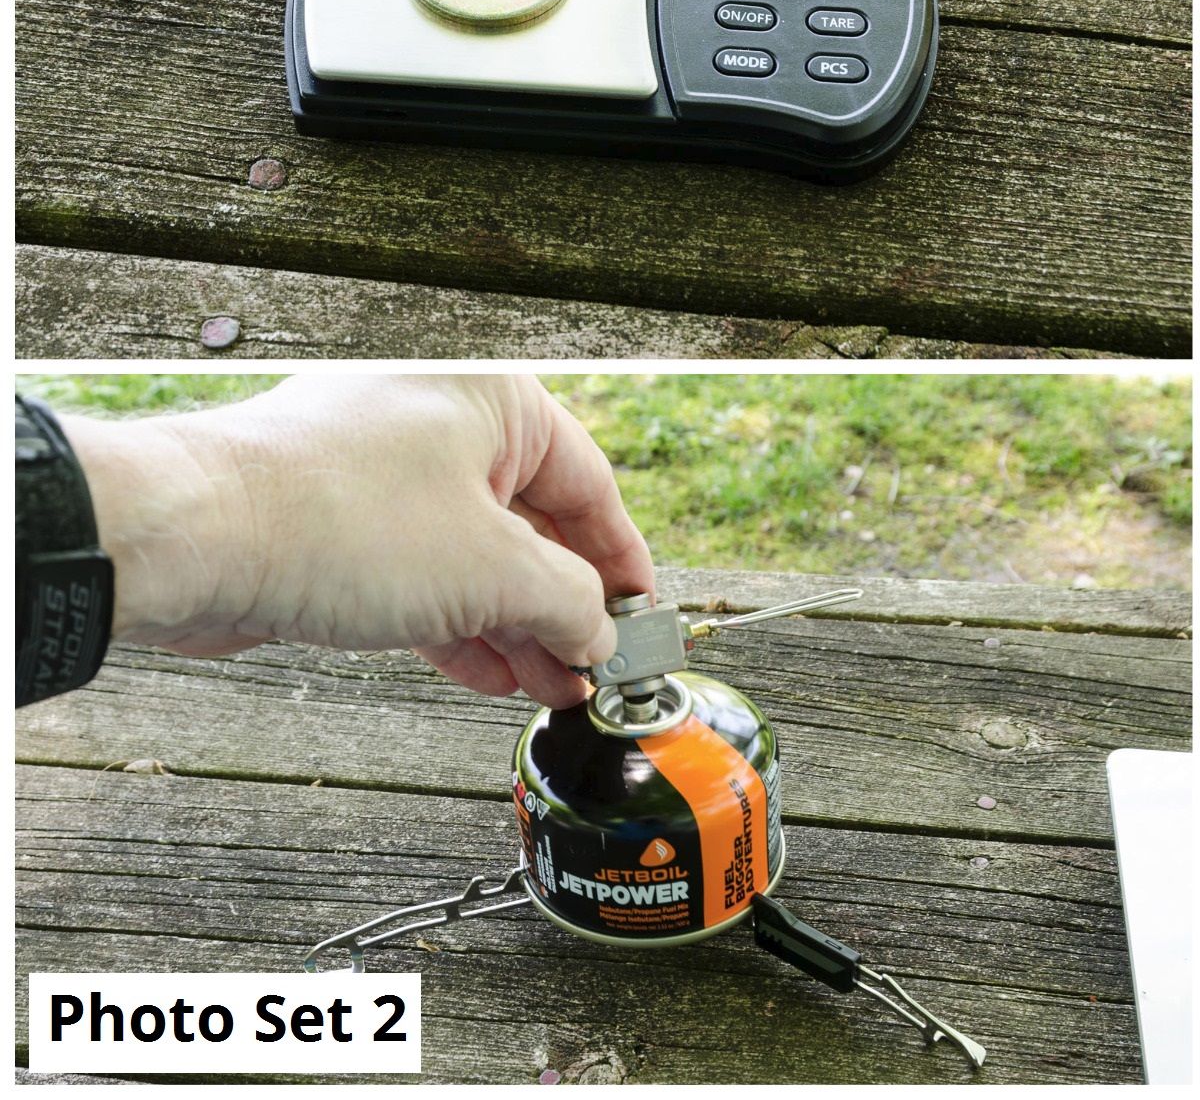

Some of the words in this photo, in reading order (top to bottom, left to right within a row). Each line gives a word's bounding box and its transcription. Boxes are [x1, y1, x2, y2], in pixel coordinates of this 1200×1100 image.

[719, 8, 773, 25] ON/OFF
[820, 16, 855, 29] TARE
[722, 54, 769, 70] MODE
[819, 61, 849, 75] PCS
[54, 581, 90, 689] SPOR
[728, 777, 755, 893] ADVENTURES
[594, 866, 689, 883] JETBOIL
[734, 835, 746, 904] BIGGER
[558, 870, 689, 905] JETPOWER
[724, 860, 735, 910] FUEL
